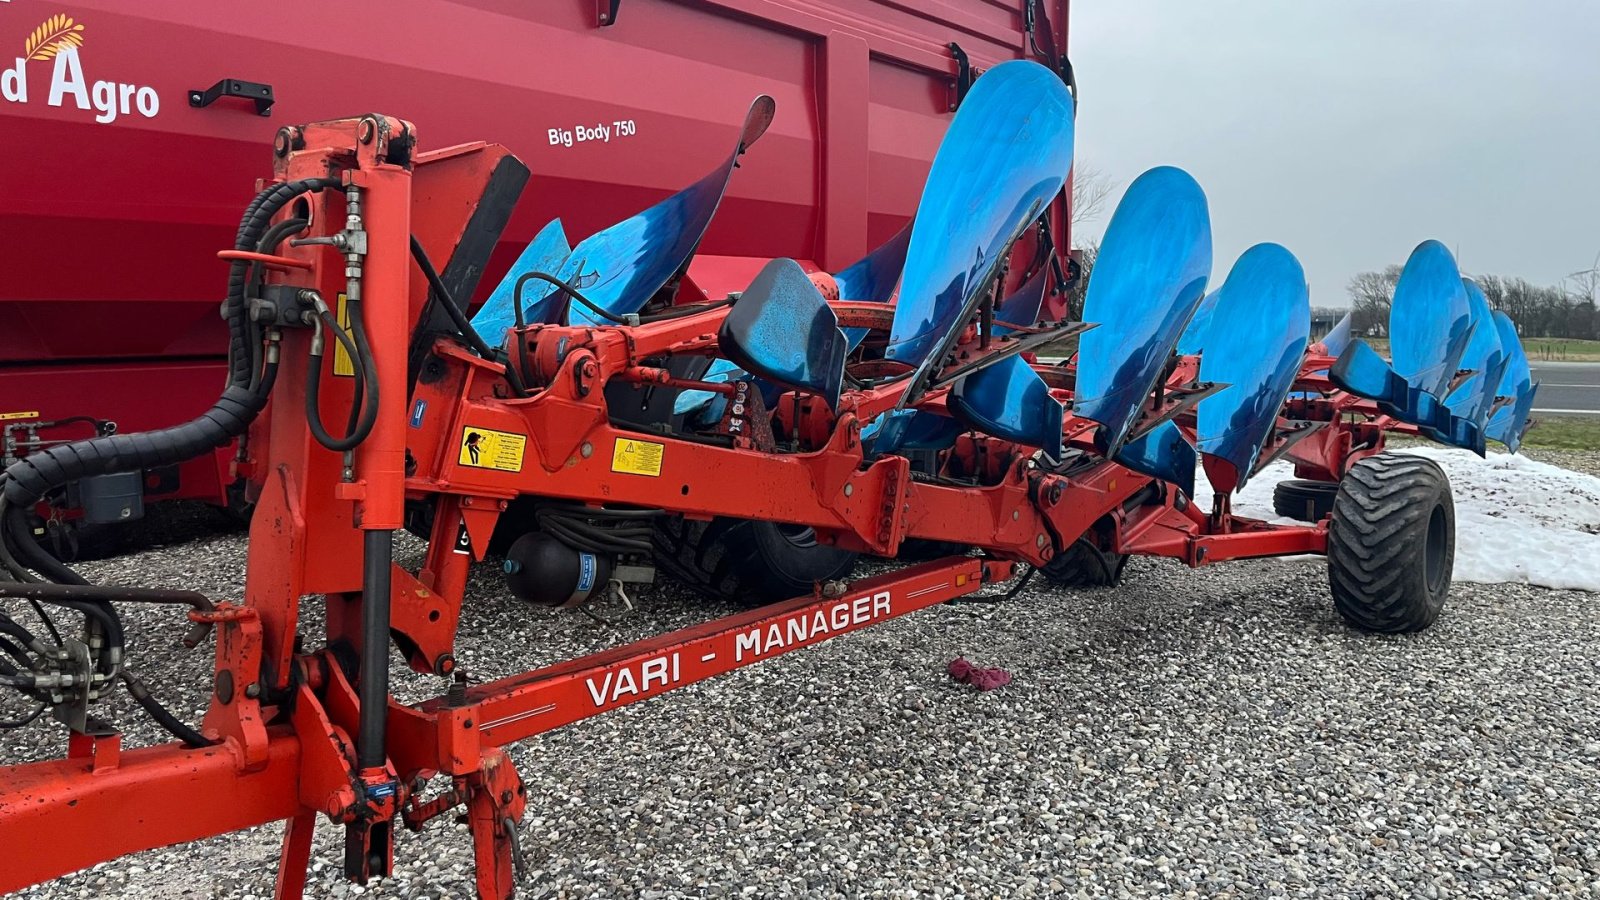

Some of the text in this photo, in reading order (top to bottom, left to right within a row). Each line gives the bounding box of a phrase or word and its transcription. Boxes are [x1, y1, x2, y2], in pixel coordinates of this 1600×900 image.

[48, 41, 160, 123] Agro
[548, 119, 636, 147] Big Body 750
[586, 591, 892, 707] VARI - MANAGER
